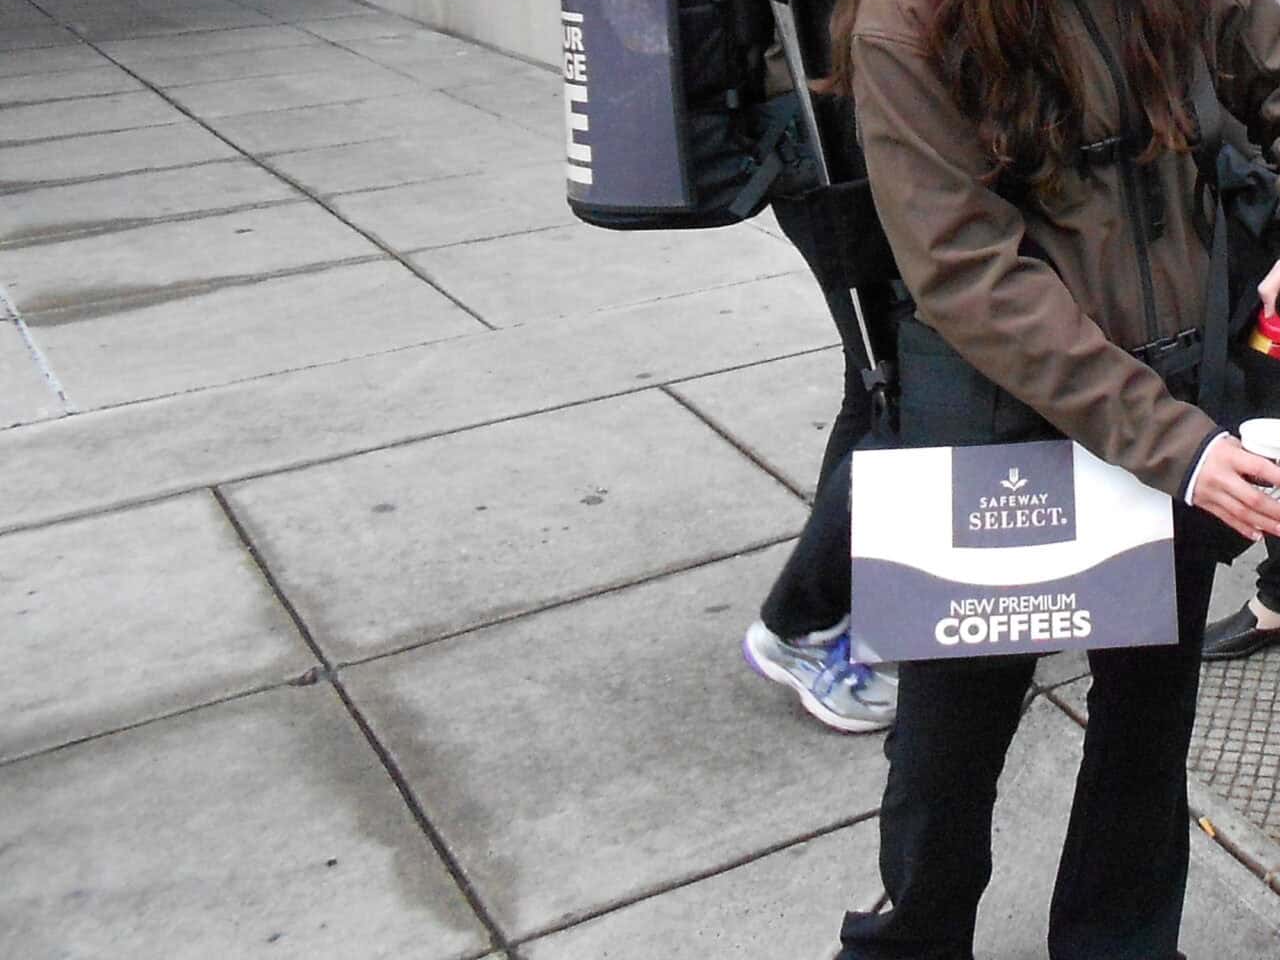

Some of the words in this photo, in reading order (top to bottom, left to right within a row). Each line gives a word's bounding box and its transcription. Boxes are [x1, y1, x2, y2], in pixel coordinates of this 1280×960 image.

[979, 493, 1049, 509] SAFEWAY
[949, 597, 996, 617] NEW
[998, 593, 1077, 614] PREMIUM
[935, 609, 1092, 646] COFFEES
